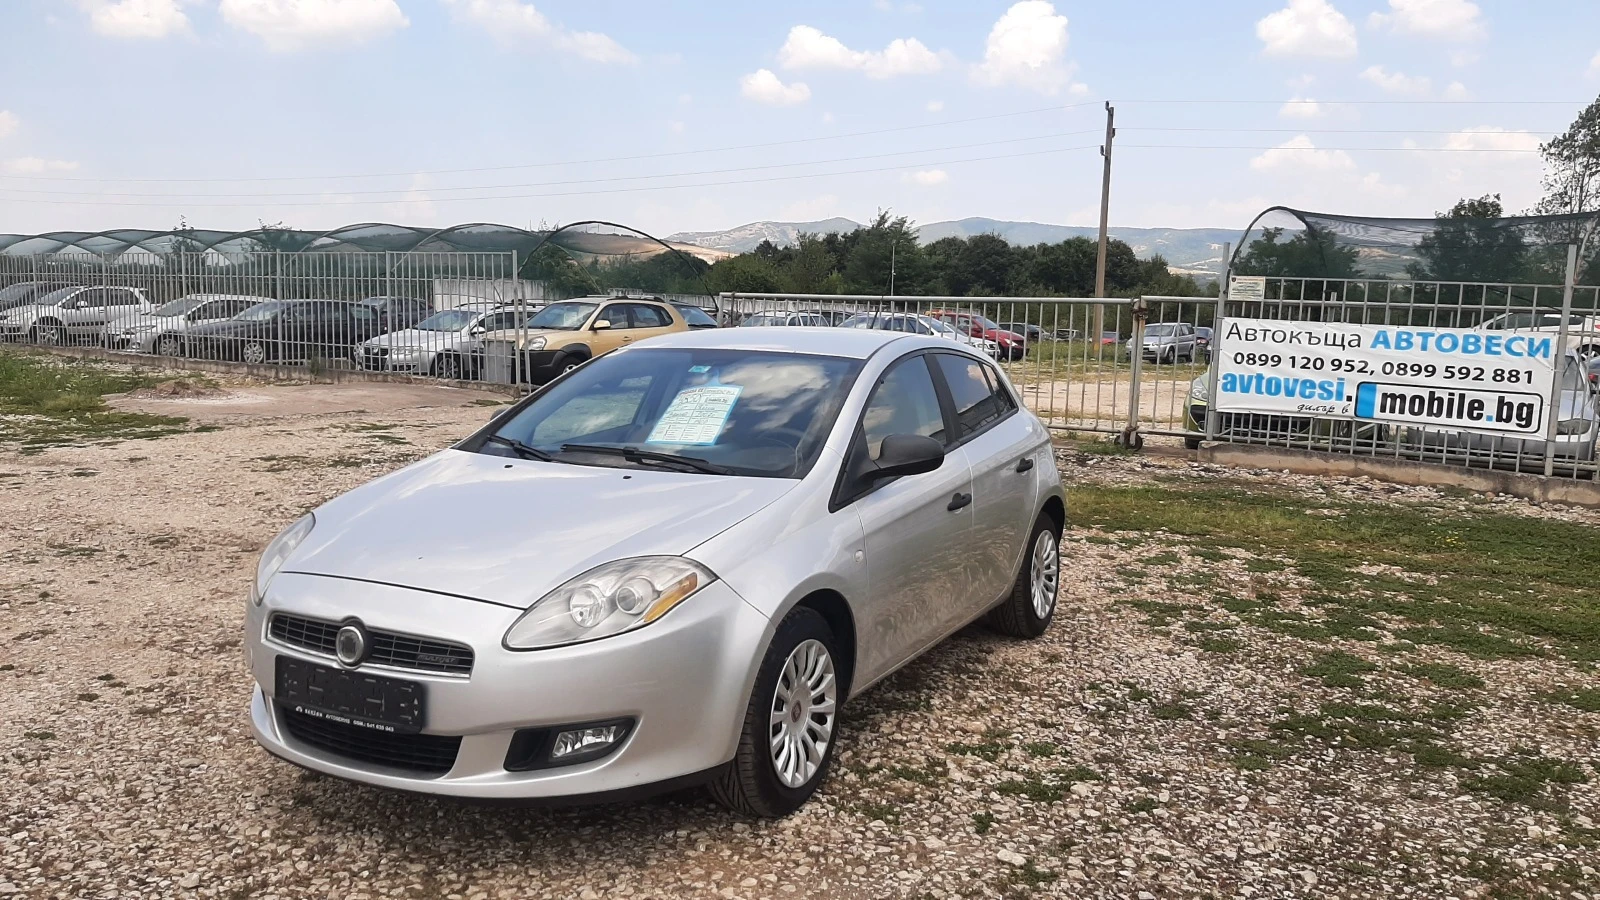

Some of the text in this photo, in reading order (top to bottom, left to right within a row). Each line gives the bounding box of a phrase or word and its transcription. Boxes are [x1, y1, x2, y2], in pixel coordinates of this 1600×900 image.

[1226, 322, 1551, 358] Автокъща АВТОВЕСИ
[1233, 352, 1533, 385] 0899 120 952, 0899 592 881
[1379, 391, 1534, 429] mobile.bg
